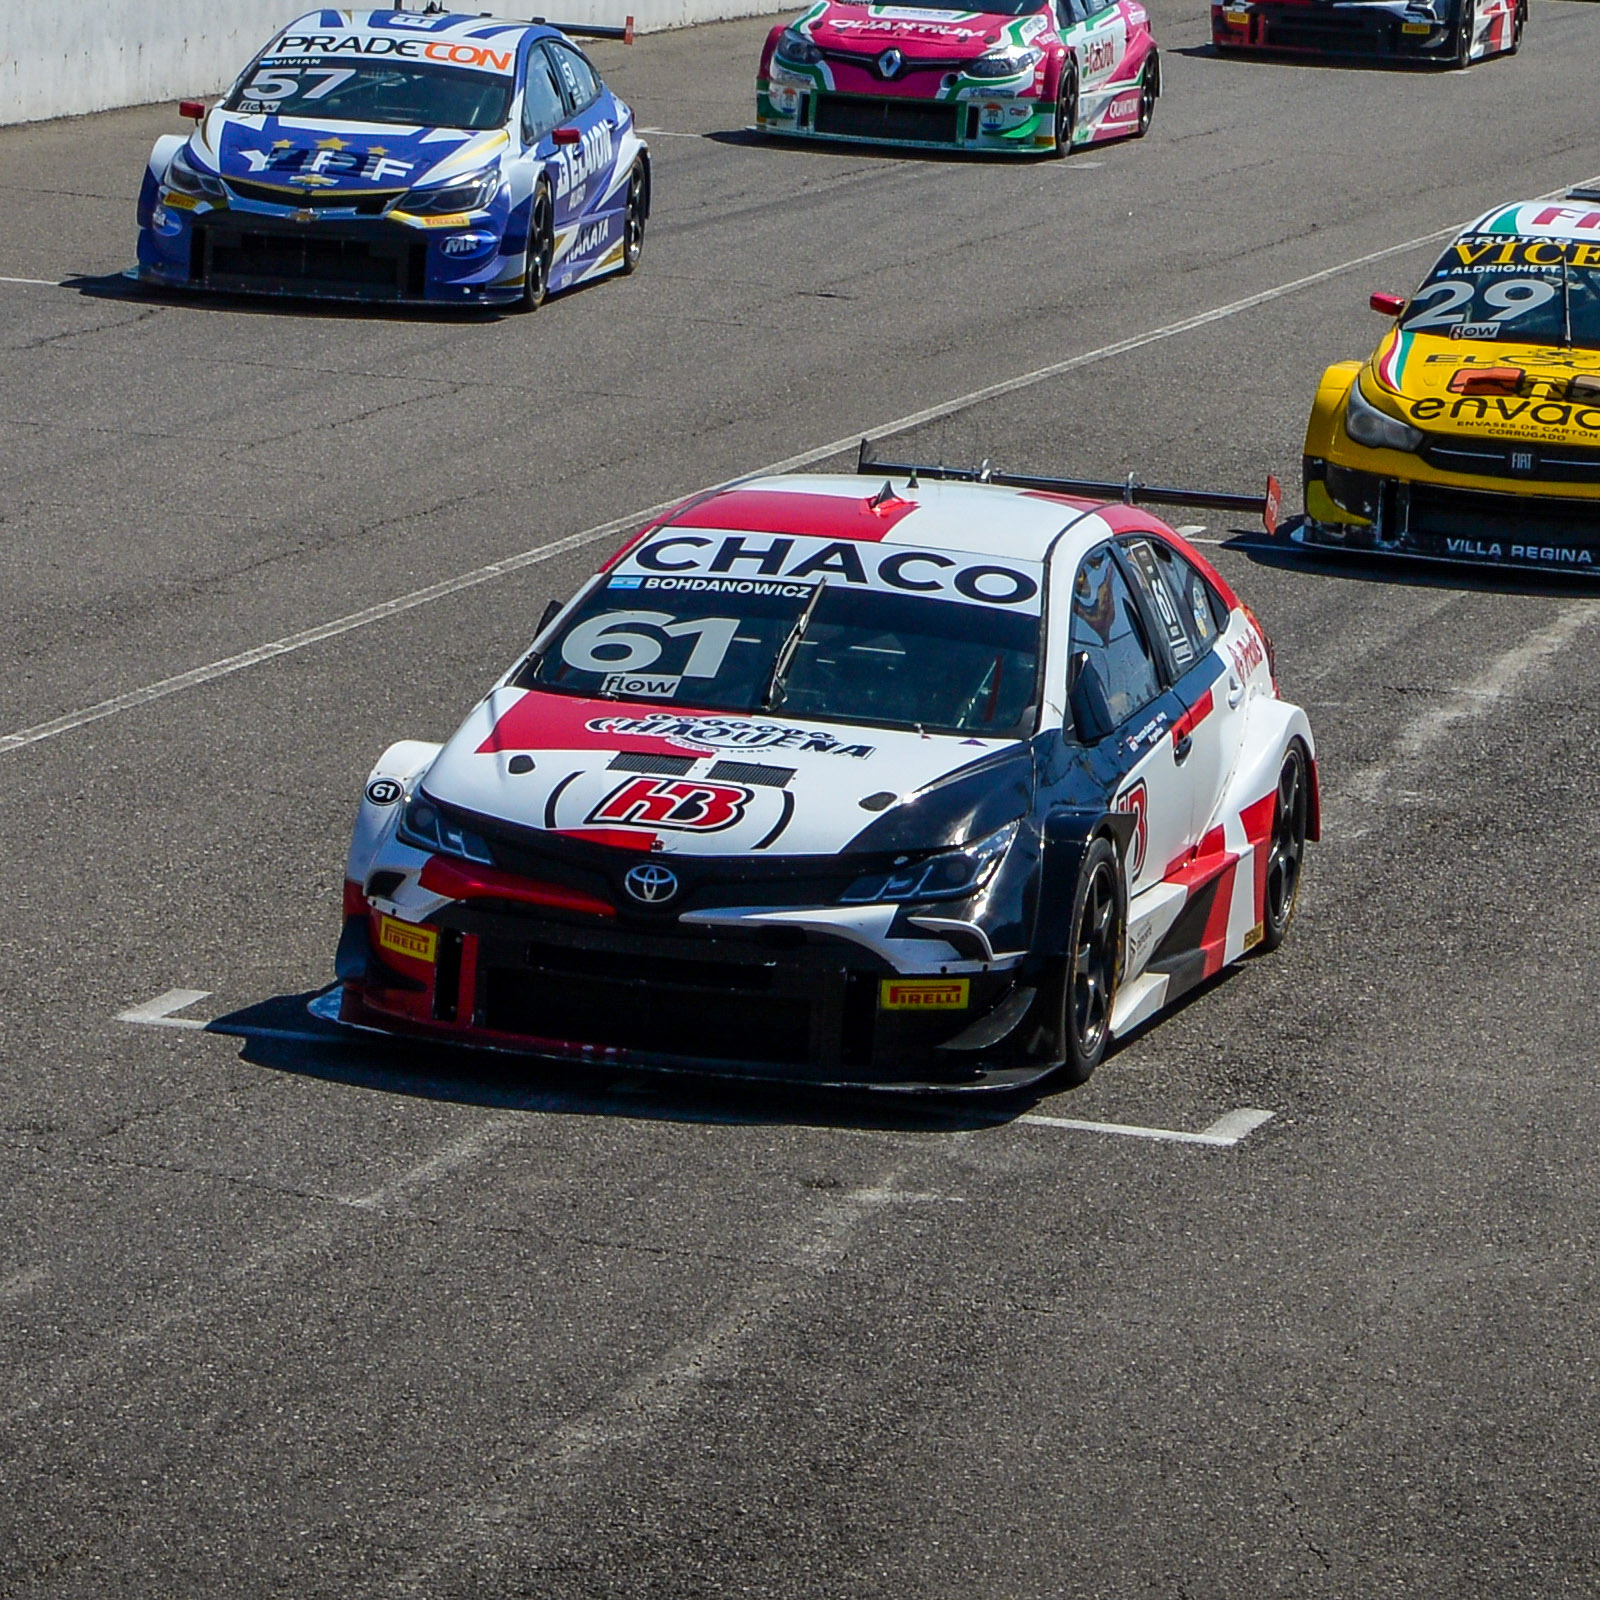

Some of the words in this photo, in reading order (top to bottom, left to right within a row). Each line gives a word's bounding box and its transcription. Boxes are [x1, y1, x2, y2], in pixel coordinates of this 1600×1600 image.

[828, 19, 988, 37] QUANTIUM
[272, 58, 321, 66] VIVIAN
[275, 35, 513, 71] PRADECON
[242, 67, 356, 100] 57
[1457, 236, 1574, 246] FRUTAS
[1403, 279, 1557, 330] 29
[1457, 420, 1516, 430] ENVASES
[1543, 424, 1599, 439] CARTÓN
[1487, 428, 1566, 441] CORRUGADO
[1511, 453, 1533, 471] FIAT
[1447, 538, 1502, 556] VILLA
[1511, 544, 1592, 563] REGINA
[634, 535, 1039, 604] CHACO
[644, 576, 813, 599] BOHDANOWICZ
[561, 609, 742, 679] 61
[604, 675, 677, 697] flow
[372, 783, 396, 801] 61
[384, 923, 431, 954] PIRELLI
[888, 984, 963, 1005] PIRELLI
